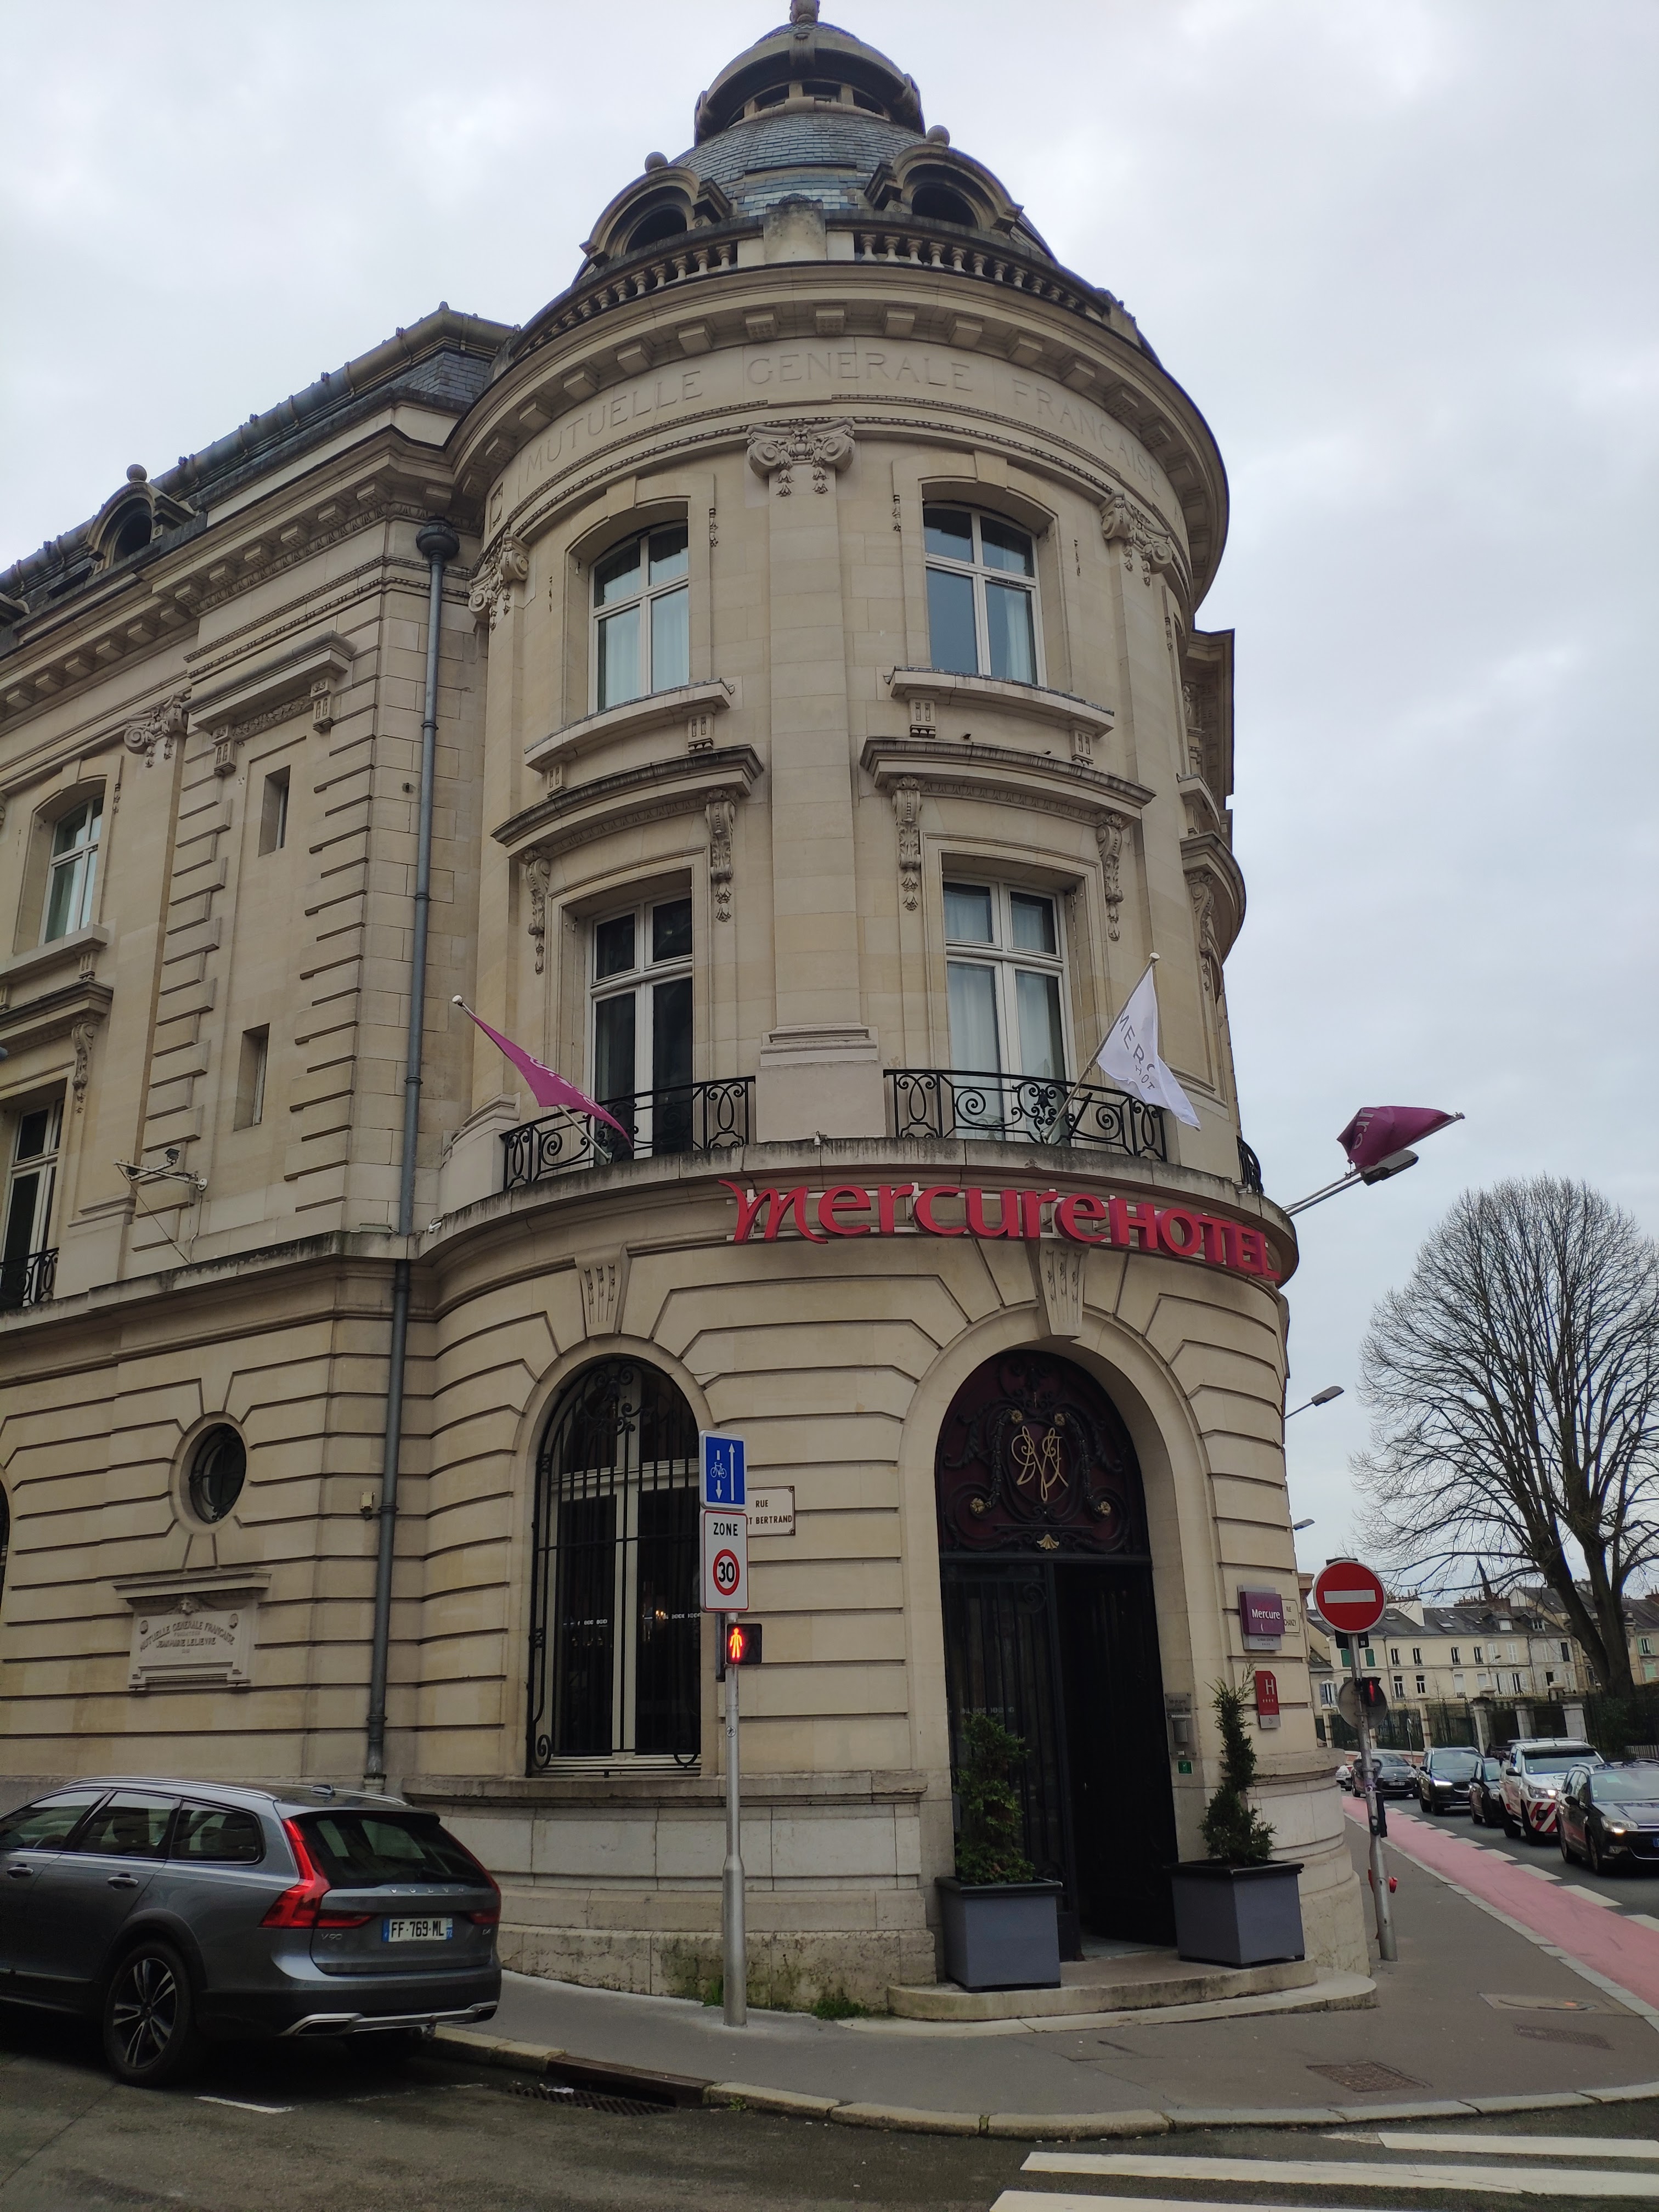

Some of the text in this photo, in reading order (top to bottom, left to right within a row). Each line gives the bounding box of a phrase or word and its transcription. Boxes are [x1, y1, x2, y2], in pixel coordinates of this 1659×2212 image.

[526, 370, 703, 483] MUTUELLE
[747, 352, 974, 392] GENERALE
[1108, 1198, 1281, 1282] HOTEL
[755, 1499, 769, 1508] RUE
[755, 1515, 792, 1525] BERTRAND
[713, 1522, 738, 1537] ZONE
[718, 1561, 735, 1583] 30
[1251, 1609, 1280, 1620] Mercure
[1265, 1679, 1275, 1695] H
